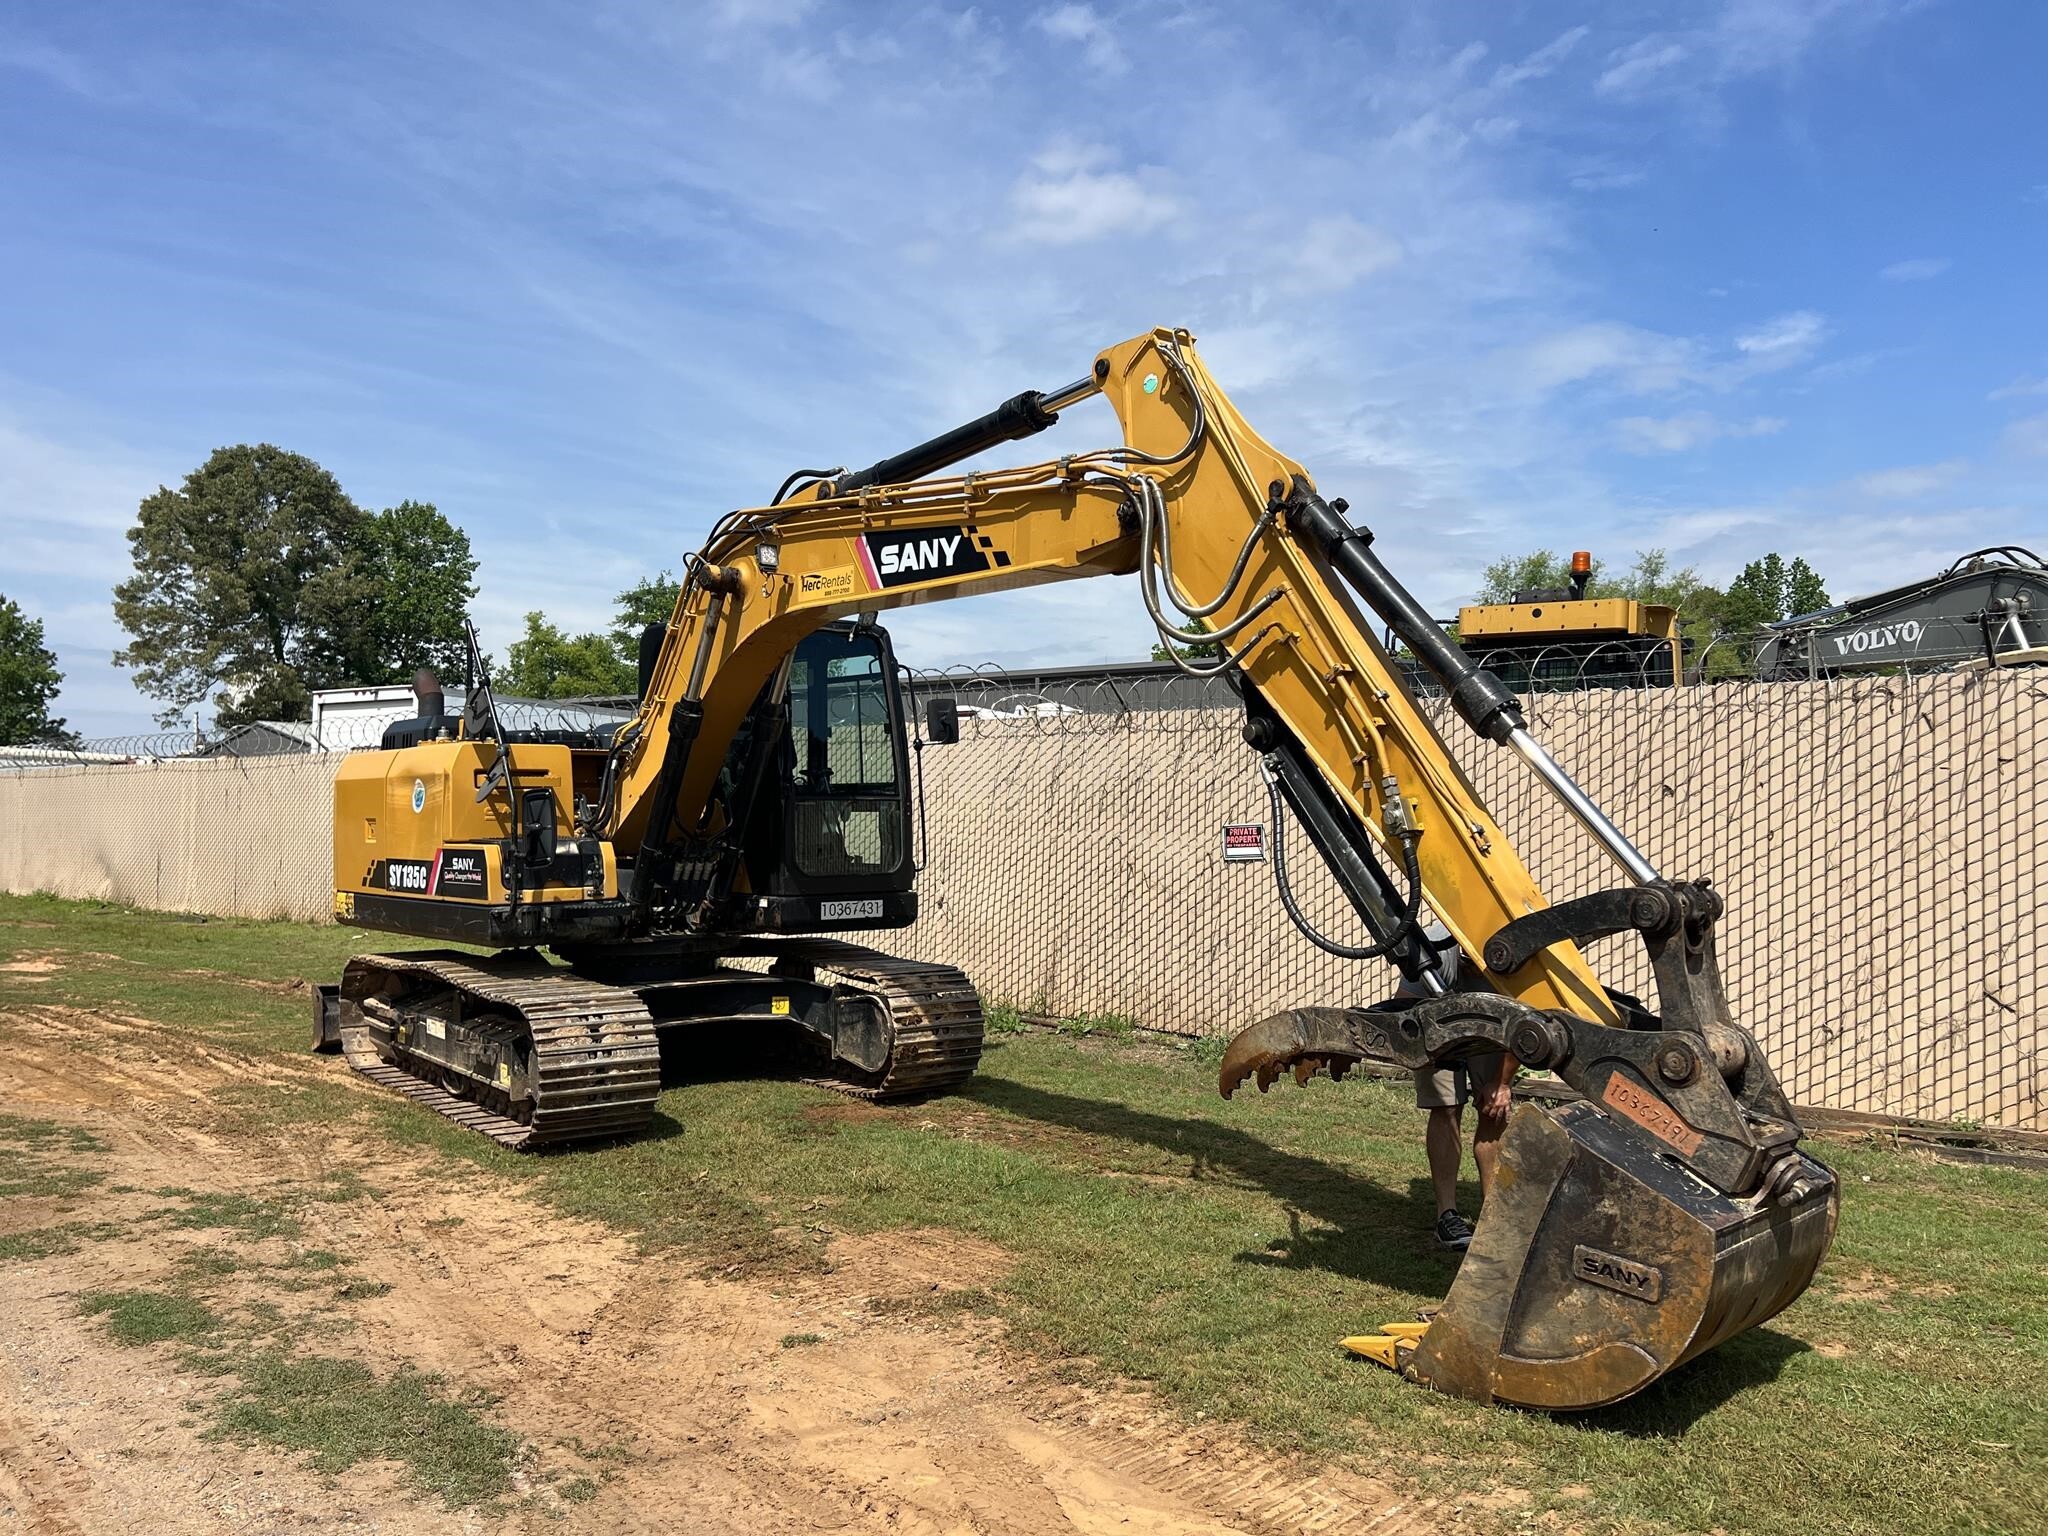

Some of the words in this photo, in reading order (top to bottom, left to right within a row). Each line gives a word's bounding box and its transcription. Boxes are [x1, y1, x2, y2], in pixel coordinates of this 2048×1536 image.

[880, 535, 962, 575] SANY
[1833, 620, 1920, 655] VOLVO
[1226, 835, 1261, 844] PROPERTY
[1230, 827, 1258, 836] PRIVATE
[452, 857, 475, 871] SANY
[389, 864, 427, 889] SY135C
[822, 901, 879, 917] 10367431
[1583, 1257, 1650, 1290] SANY
